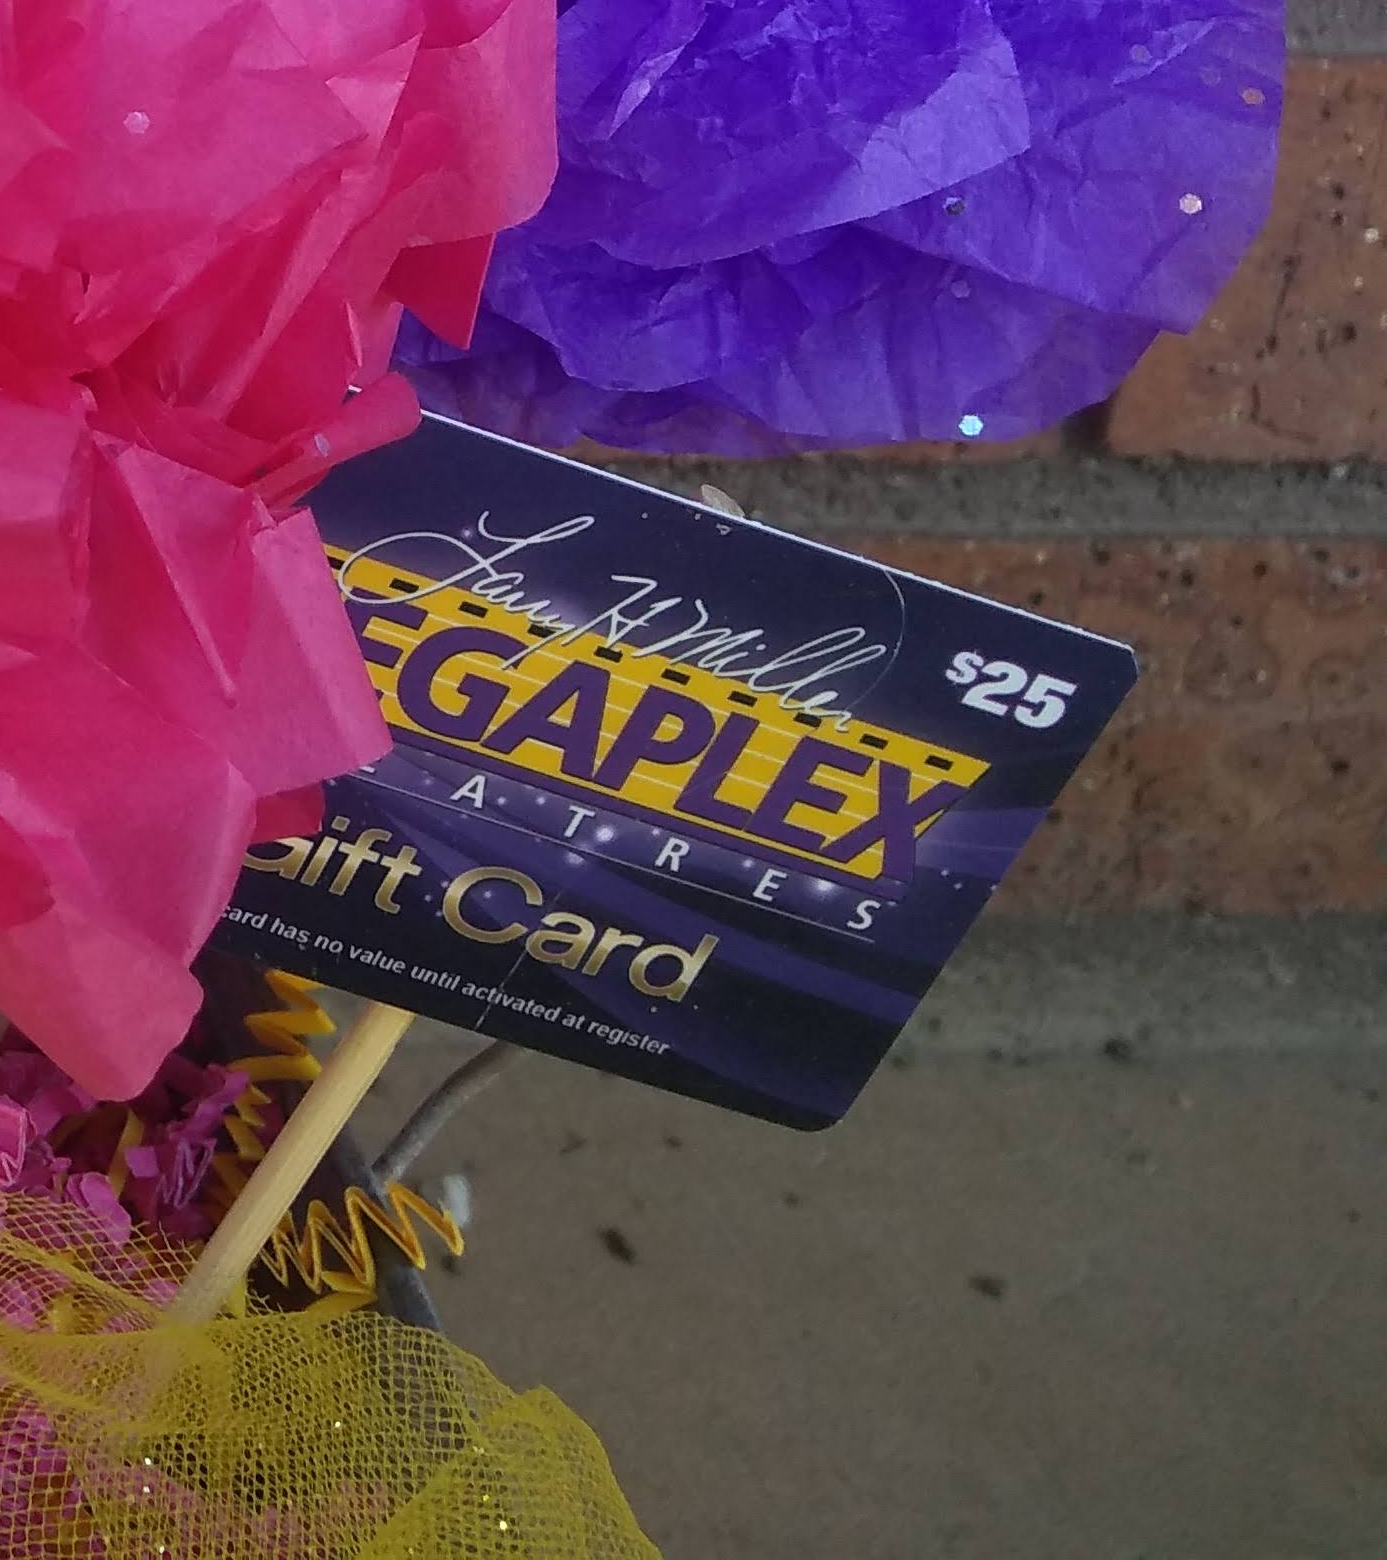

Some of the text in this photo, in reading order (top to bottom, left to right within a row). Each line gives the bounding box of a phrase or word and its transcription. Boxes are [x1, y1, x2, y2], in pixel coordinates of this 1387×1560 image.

[344, 587, 962, 885] EGAPLEX
[945, 651, 1078, 728] $25
[269, 917, 311, 943] has
[314, 934, 343, 955] no
[348, 943, 407, 975] value
[410, 965, 461, 992] until
[462, 980, 561, 1024] activated
[561, 1009, 585, 1030] at
[586, 1020, 672, 1057] register
[442, 865, 719, 1002] Card
